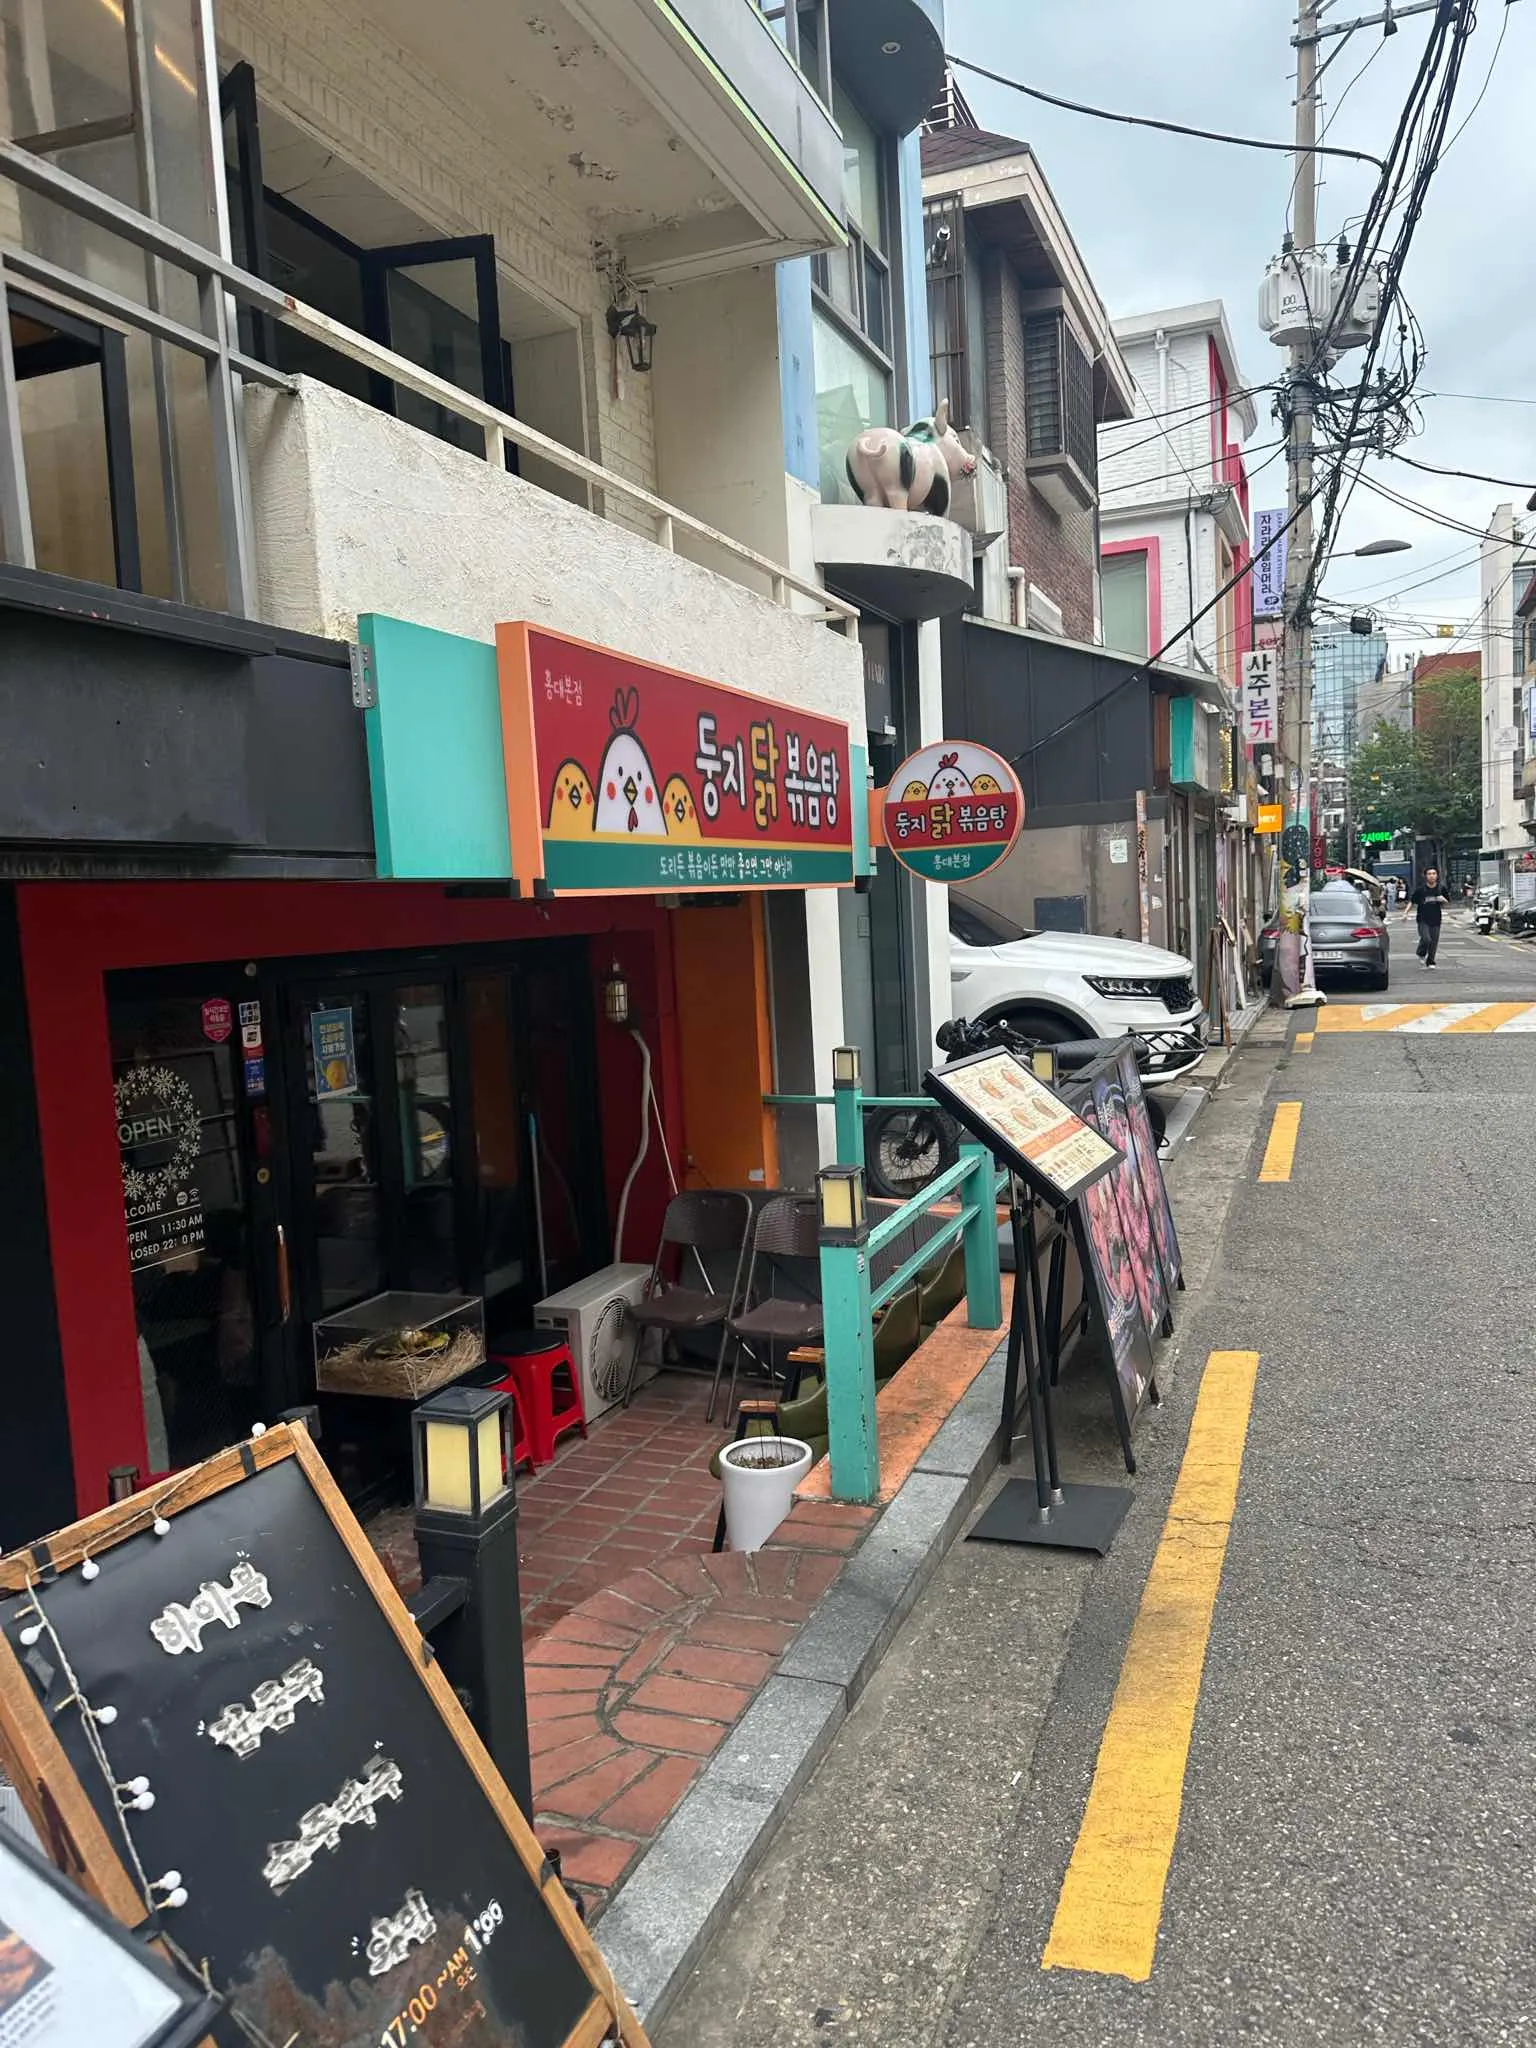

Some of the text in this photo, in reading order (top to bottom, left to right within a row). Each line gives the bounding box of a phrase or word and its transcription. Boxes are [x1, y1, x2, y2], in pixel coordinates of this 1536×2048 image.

[544, 669, 583, 706] 홍대본점
[1246, 653, 1273, 739] 사주본가
[696, 712, 840, 831] 둥지 닭 볶음탕
[895, 803, 1008, 839] 둥지 닭 볶음탕
[659, 852, 684, 879] 도리든
[687, 851, 718, 880] 볶음이든
[737, 852, 758, 880] 좋으면
[760, 855, 772, 878] 그만
[933, 852, 971, 871] 홍대본점
[118, 1115, 172, 1144] OPEN
[127, 1213, 203, 1244] PEN 11:30 AM
[190, 1229, 204, 1242] PM
